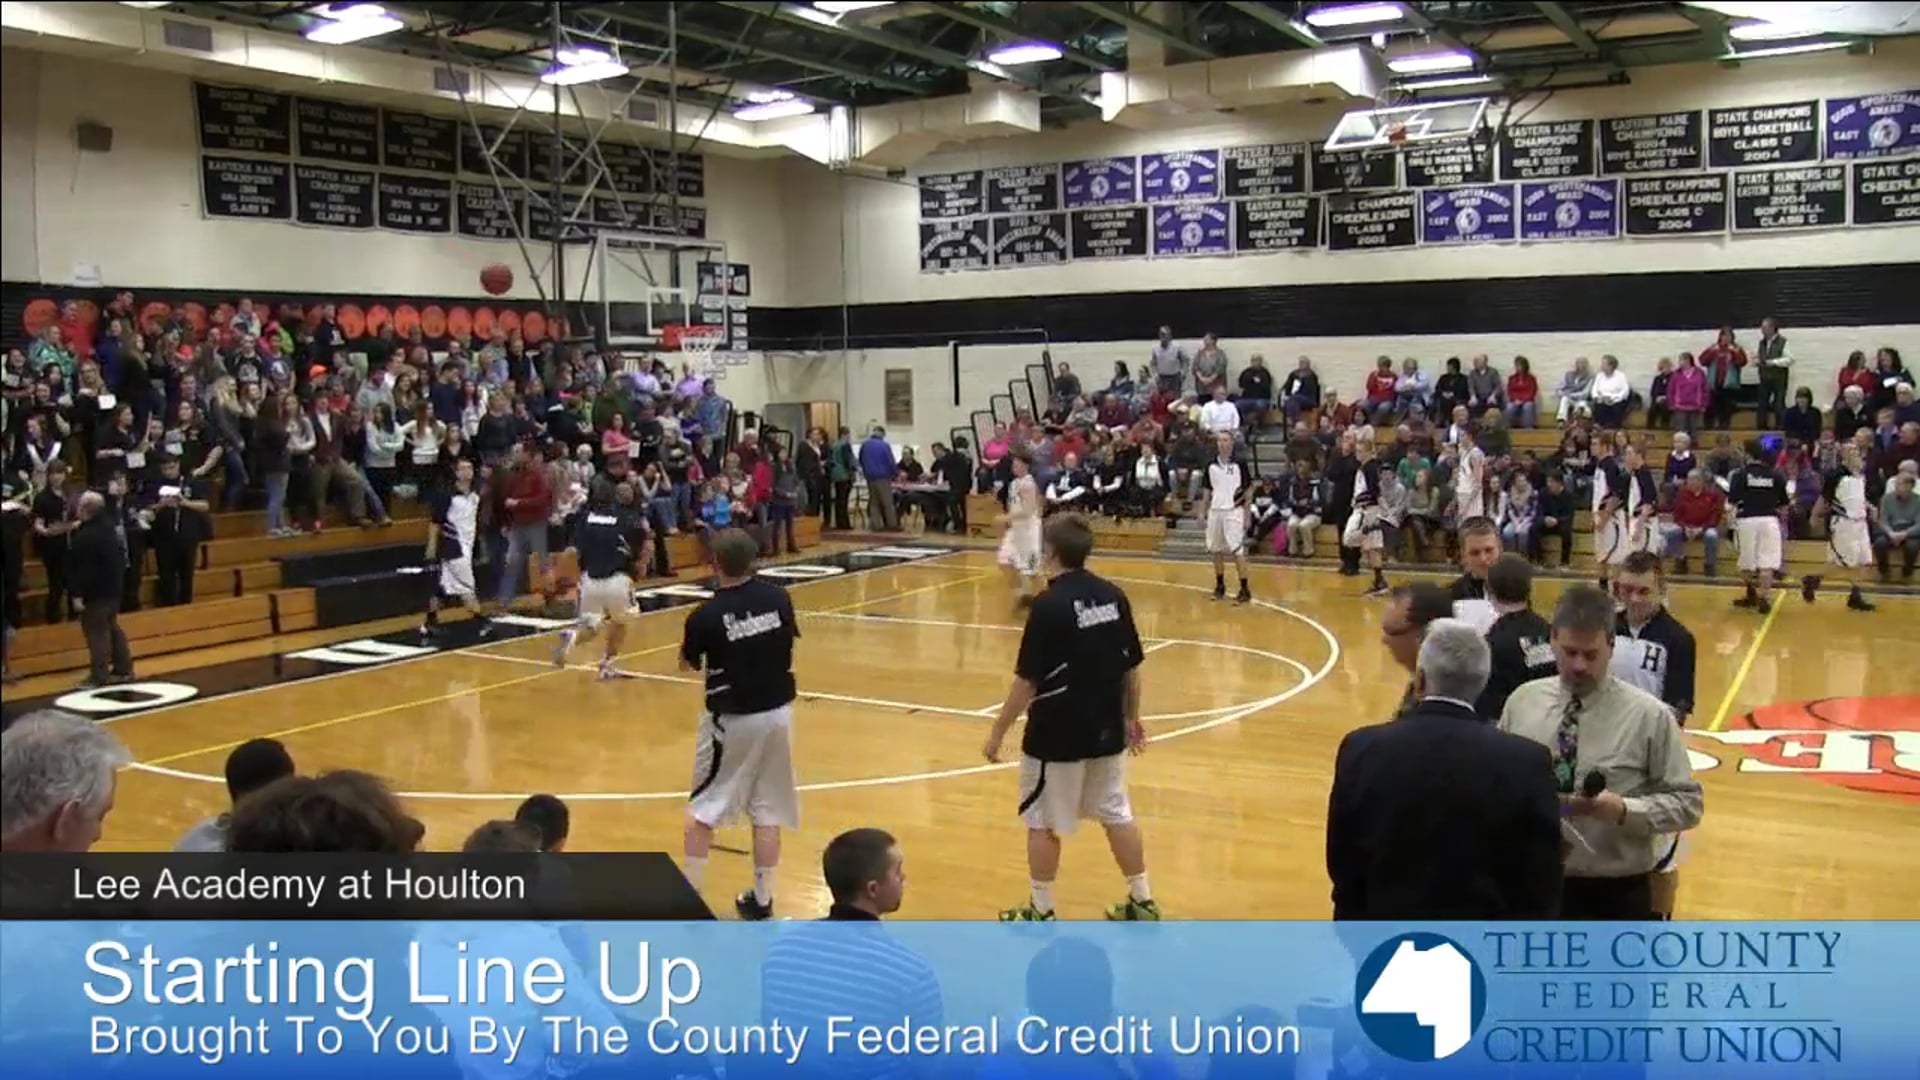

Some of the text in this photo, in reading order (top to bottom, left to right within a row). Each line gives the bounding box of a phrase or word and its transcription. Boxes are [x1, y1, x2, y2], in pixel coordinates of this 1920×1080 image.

[1716, 105, 1811, 125] STATE CHAMPIONS
[1616, 126, 1686, 141] CHAMPIONS
[1713, 120, 1814, 139] BOYS BASKETBALL
[1833, 129, 1861, 141] EAST
[1514, 134, 1578, 148] CHAMPIONS
[1733, 135, 1793, 150] CLASS C
[1633, 147, 1697, 159] BASKETBALL
[1743, 150, 1781, 161] 2004
[1624, 159, 1666, 170] CLASS
[1737, 167, 1843, 185] STATE RUNNERS-UP
[1862, 165, 1900, 179] STATE
[1630, 178, 1721, 193] STATE CHAMPIONS
[1630, 192, 1724, 207] CHEERLEADING
[1770, 195, 1807, 206] 2004
[1647, 207, 1690, 218] CLASS
[1753, 203, 1825, 217] SOFTBALL
[1759, 215, 1805, 227] CLASS
[1347, 223, 1384, 235] CLASS
[1640, 646, 1663, 674] H
